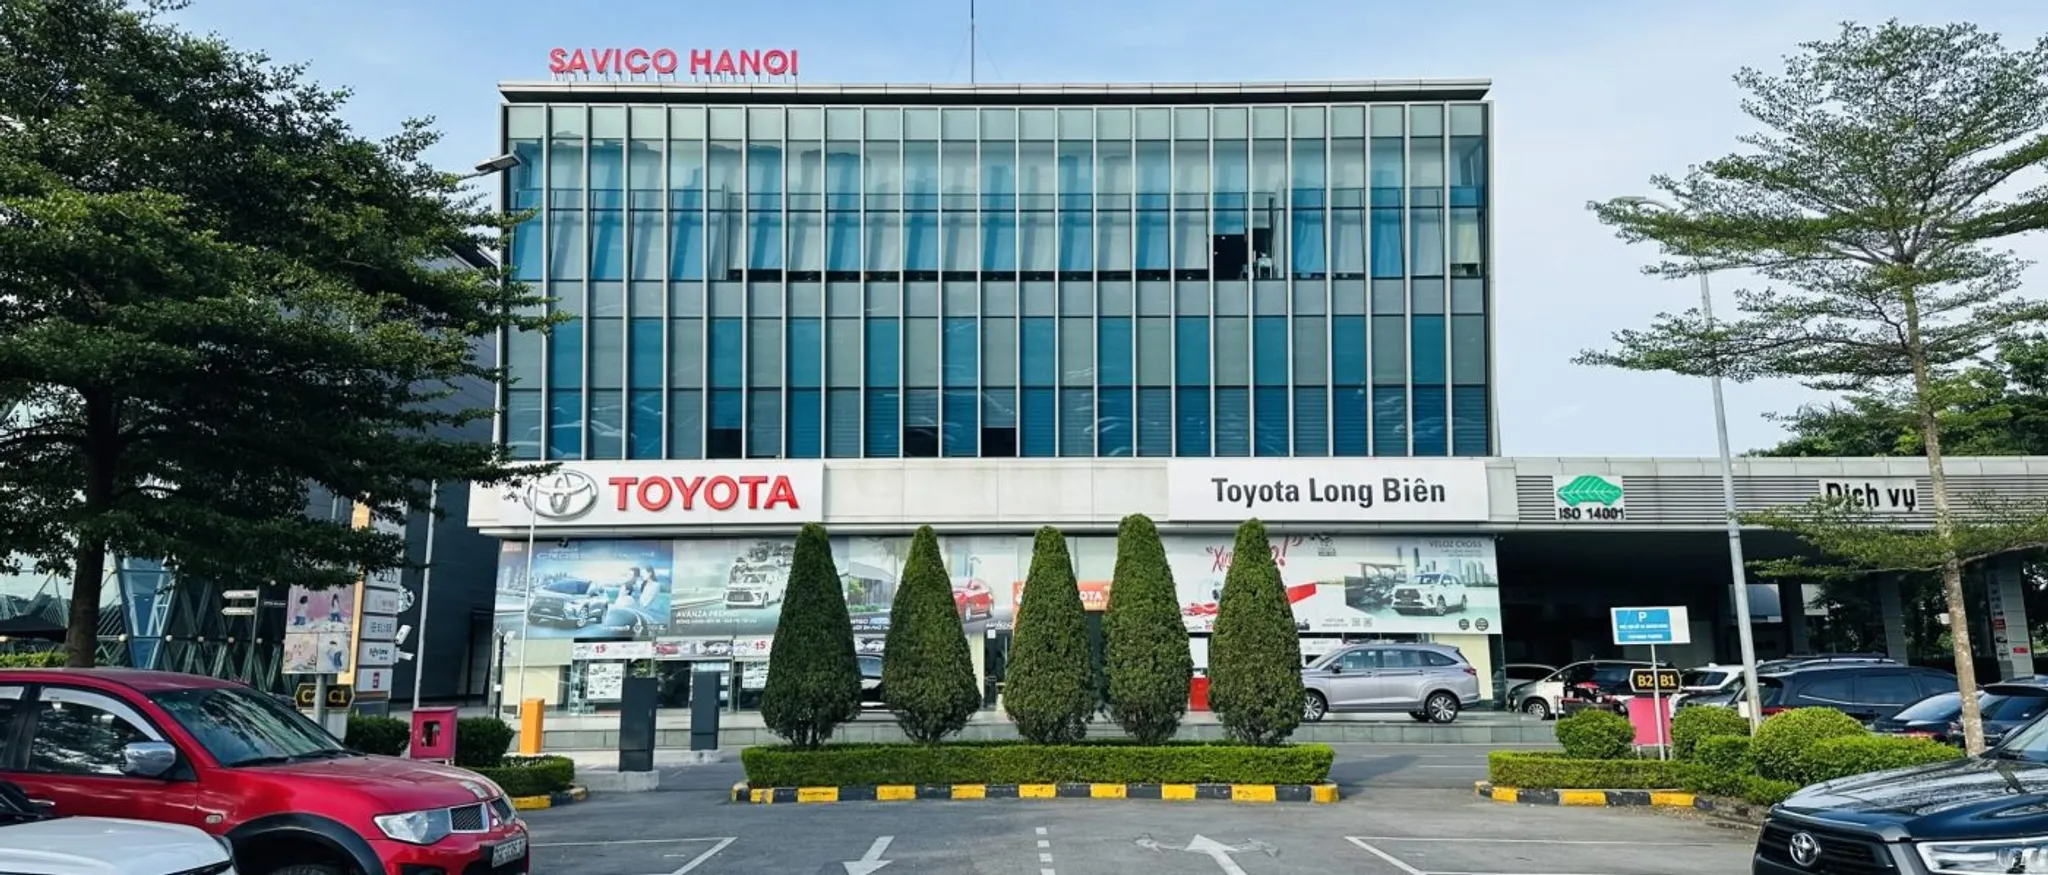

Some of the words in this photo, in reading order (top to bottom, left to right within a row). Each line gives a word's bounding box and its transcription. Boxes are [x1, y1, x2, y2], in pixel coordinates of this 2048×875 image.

[549, 48, 678, 74] SAVICO
[690, 49, 799, 75] HANOI
[608, 474, 800, 512] TOYOTA
[1211, 477, 1300, 508] Toyota
[1309, 477, 1374, 508] Long
[1382, 477, 1446, 503] Biên
[1887, 488, 1916, 512] vụ
[1559, 507, 1581, 520] ISO
[1586, 507, 1625, 520] 14001
[676, 610, 707, 619] AVANZA
[1638, 611, 1647, 622] P
[1638, 674, 1654, 687] B2
[1660, 674, 1677, 687] B1
[328, 690, 346, 704] C1
